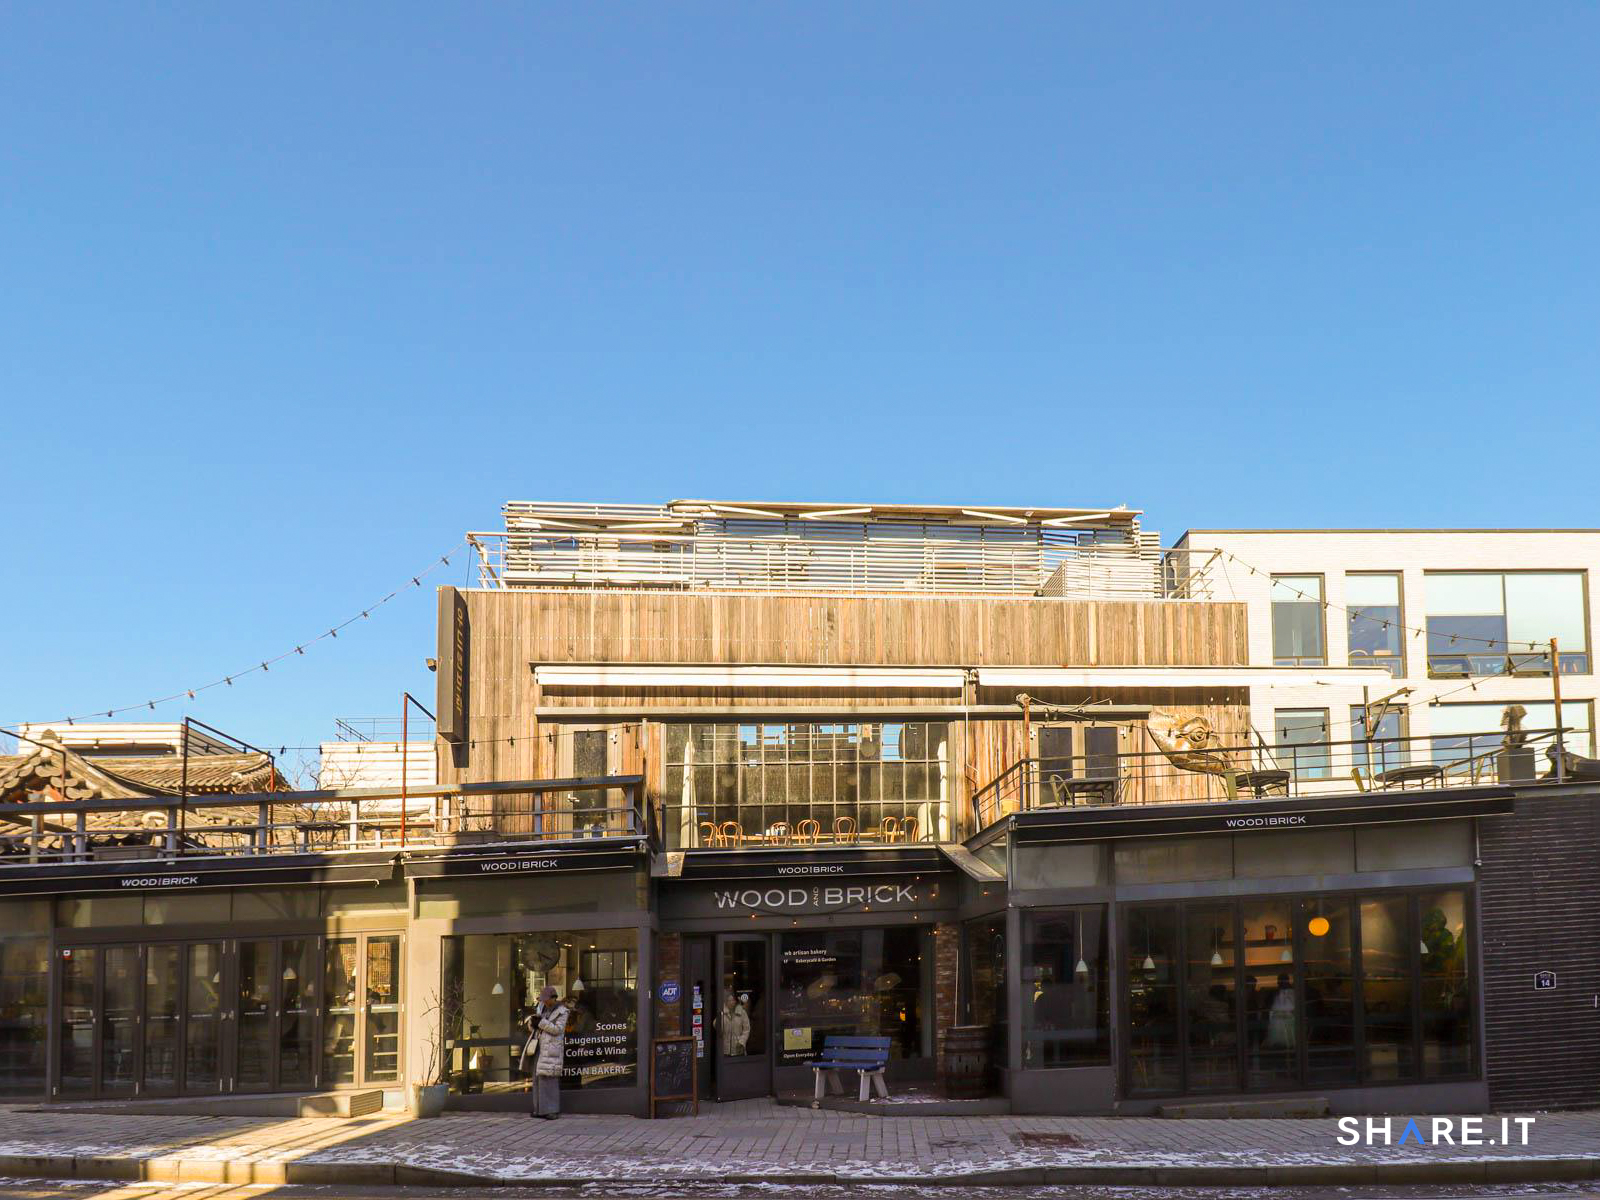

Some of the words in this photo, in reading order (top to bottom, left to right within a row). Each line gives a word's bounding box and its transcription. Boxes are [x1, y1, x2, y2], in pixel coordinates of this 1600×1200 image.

[1226, 818, 1264, 827] WOOD
[1269, 815, 1307, 825] BRICK
[522, 860, 558, 868] BRICK
[777, 866, 809, 874] WOOD
[813, 865, 844, 873] BRICK
[121, 879, 158, 887] WOOD
[162, 877, 198, 886] BRICK
[714, 889, 808, 909] WOOD
[824, 884, 916, 905] BRICK
[662, 987, 678, 997] ADT
[595, 1022, 627, 1031] Scones
[564, 1035, 627, 1046] Laugenstange
[565, 1048, 594, 1057] Coffee
[596, 1047, 603, 1056] &
[604, 1046, 627, 1055] Wine
[561, 1067, 588, 1077] TISAN
[591, 1065, 627, 1075] BAKERY
